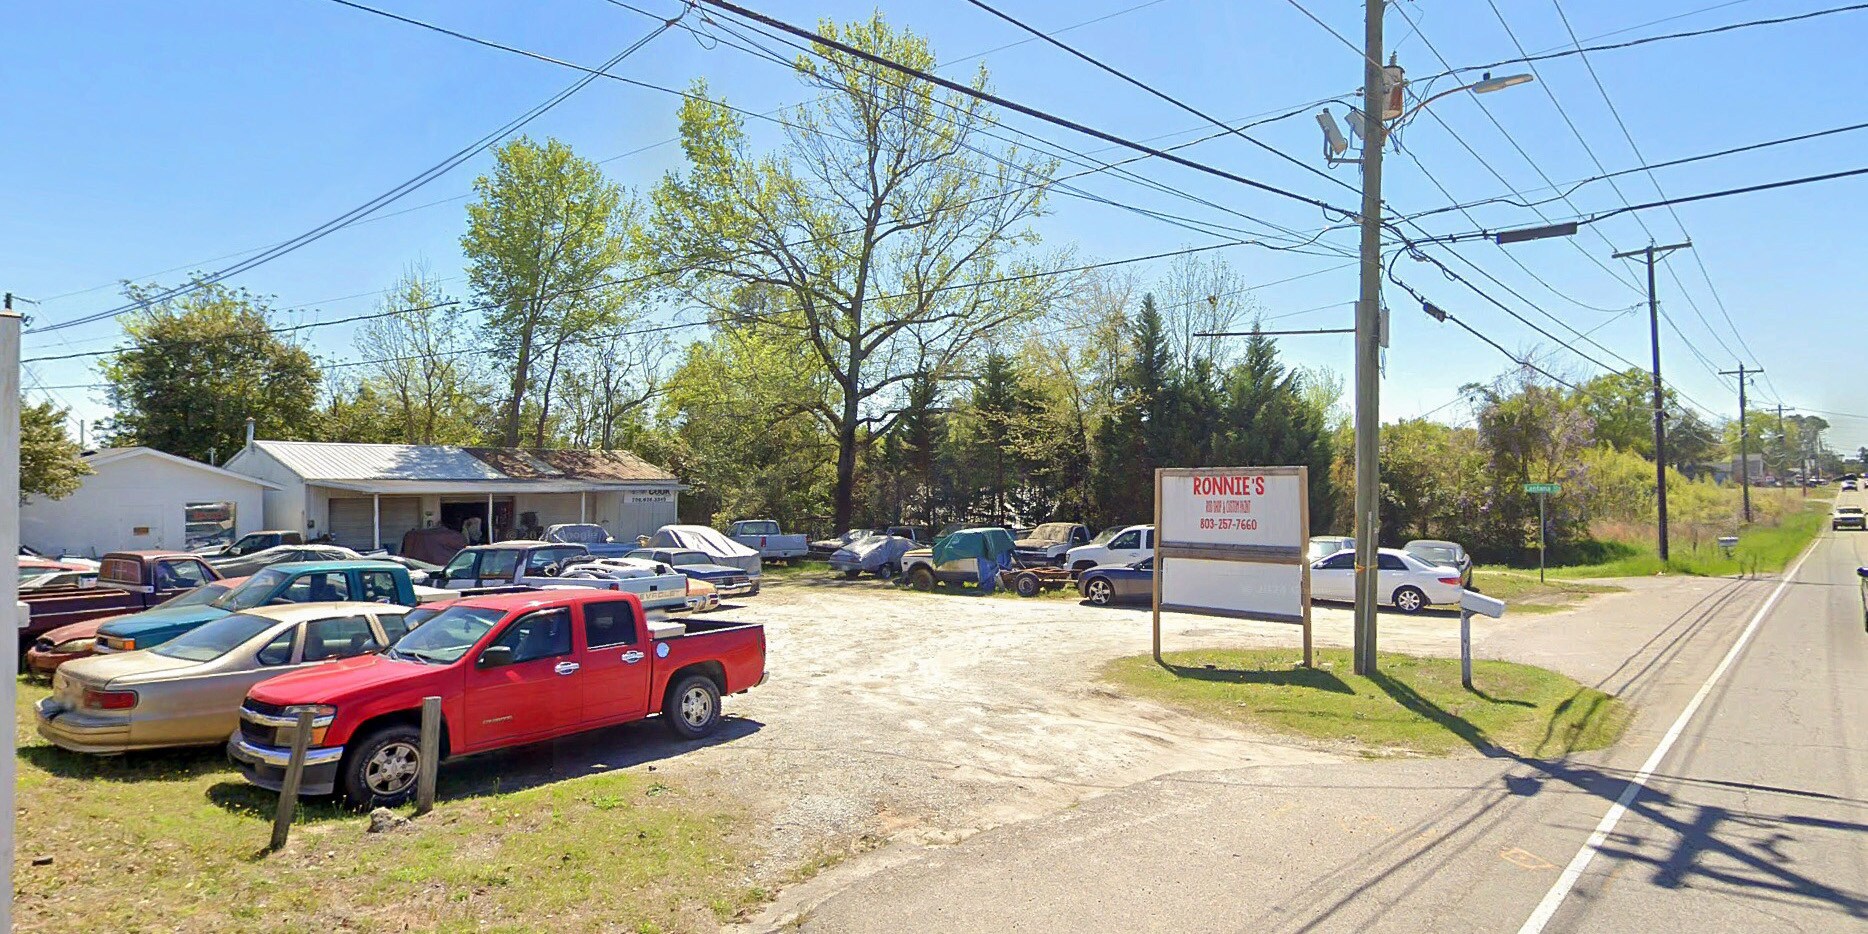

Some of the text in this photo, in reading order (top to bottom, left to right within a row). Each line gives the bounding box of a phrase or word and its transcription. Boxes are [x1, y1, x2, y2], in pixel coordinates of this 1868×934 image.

[1193, 476, 1265, 496] RONNIE'S
[1200, 518, 1258, 531] 803-257-7660
[639, 590, 680, 600] EVROLET
